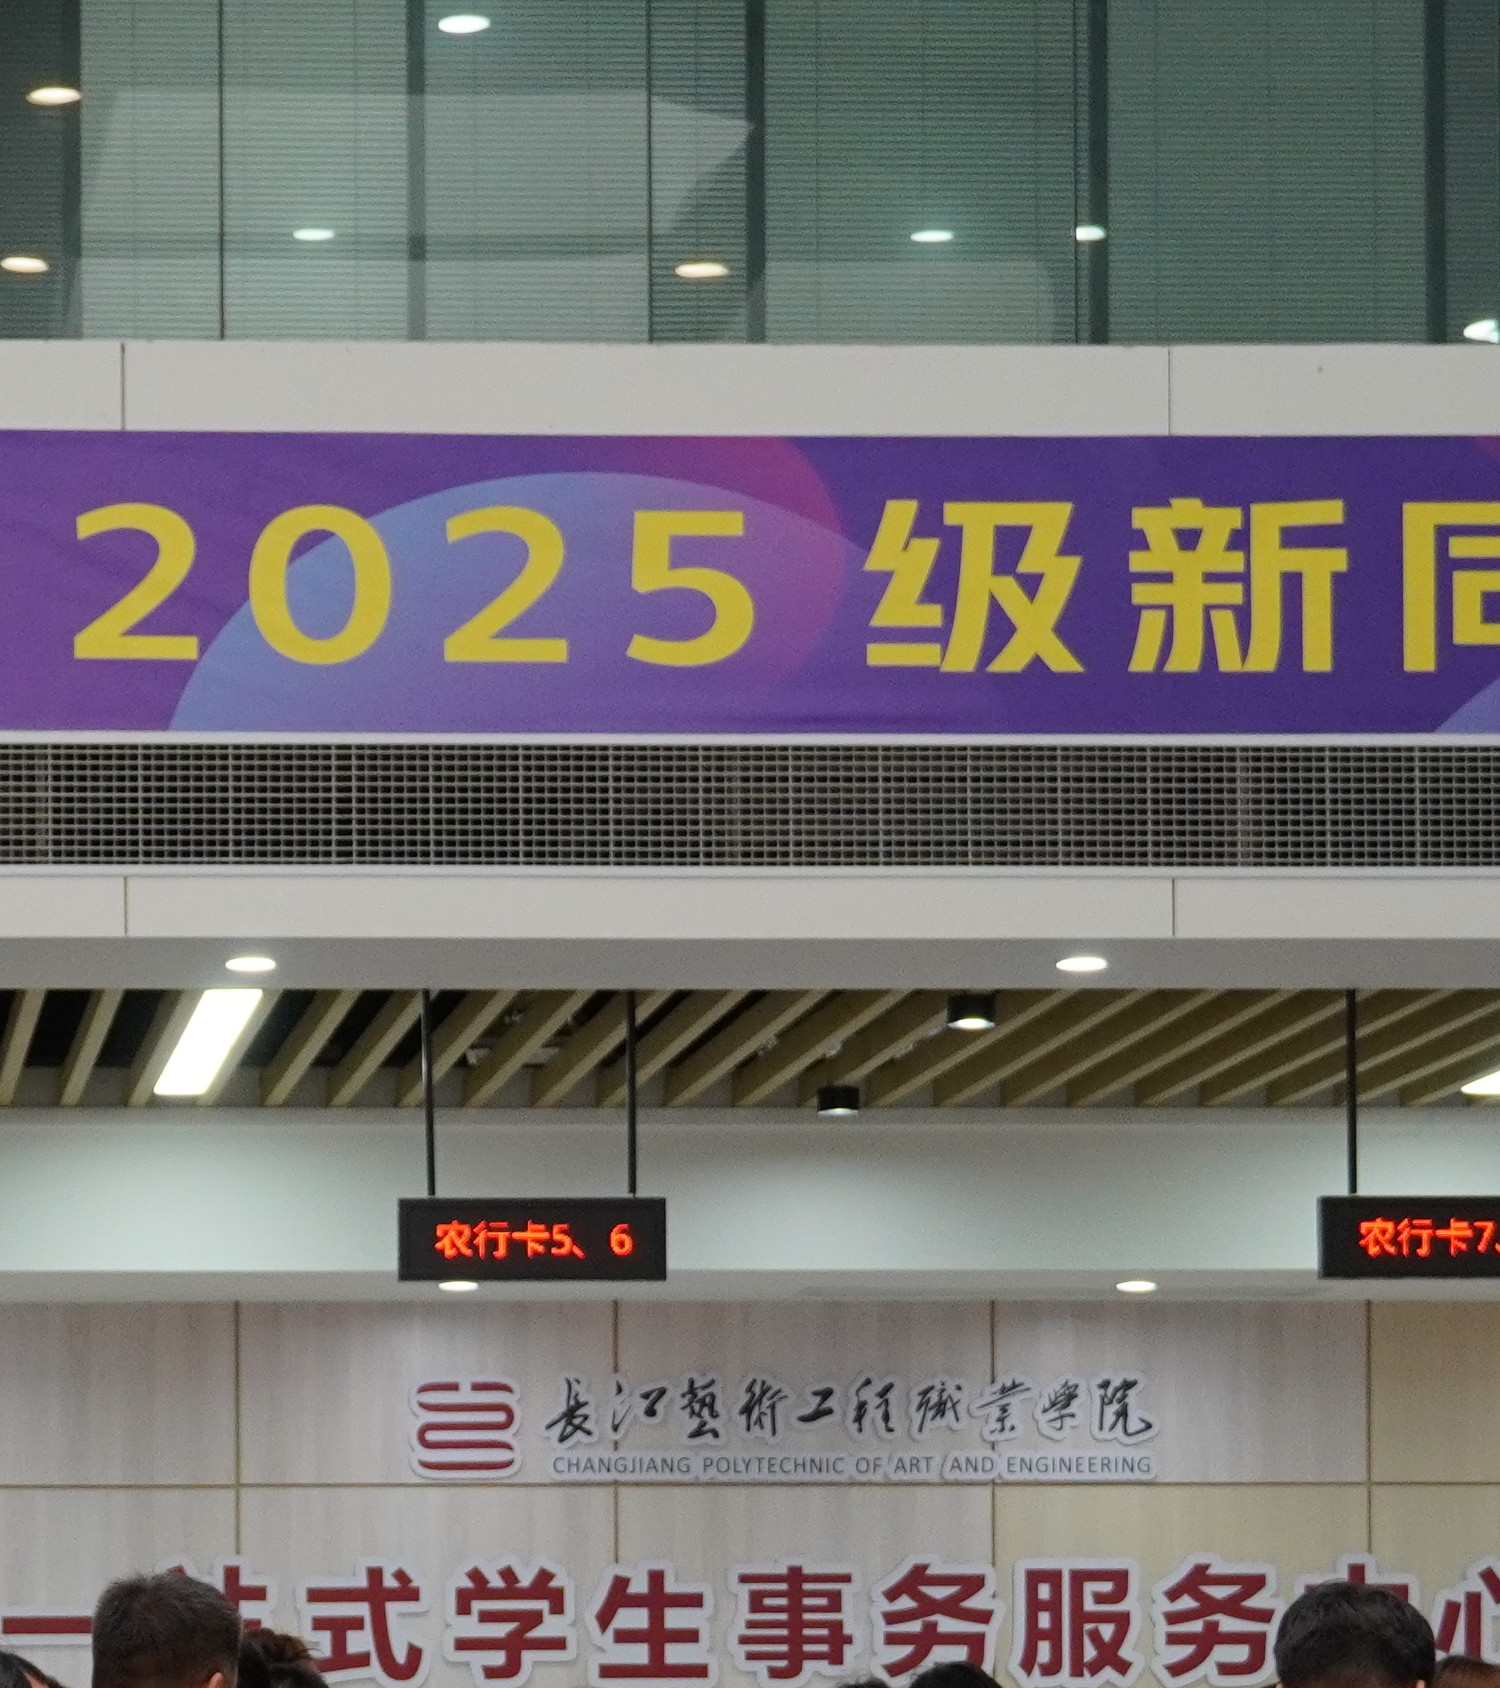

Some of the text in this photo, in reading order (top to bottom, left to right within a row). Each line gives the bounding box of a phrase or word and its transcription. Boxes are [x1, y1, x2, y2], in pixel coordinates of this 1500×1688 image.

[70, 501, 757, 668] 2025
[552, 1456, 1151, 1475] CHANGJIANG POLYTECHNIC OF ART AND ENGINEERING
